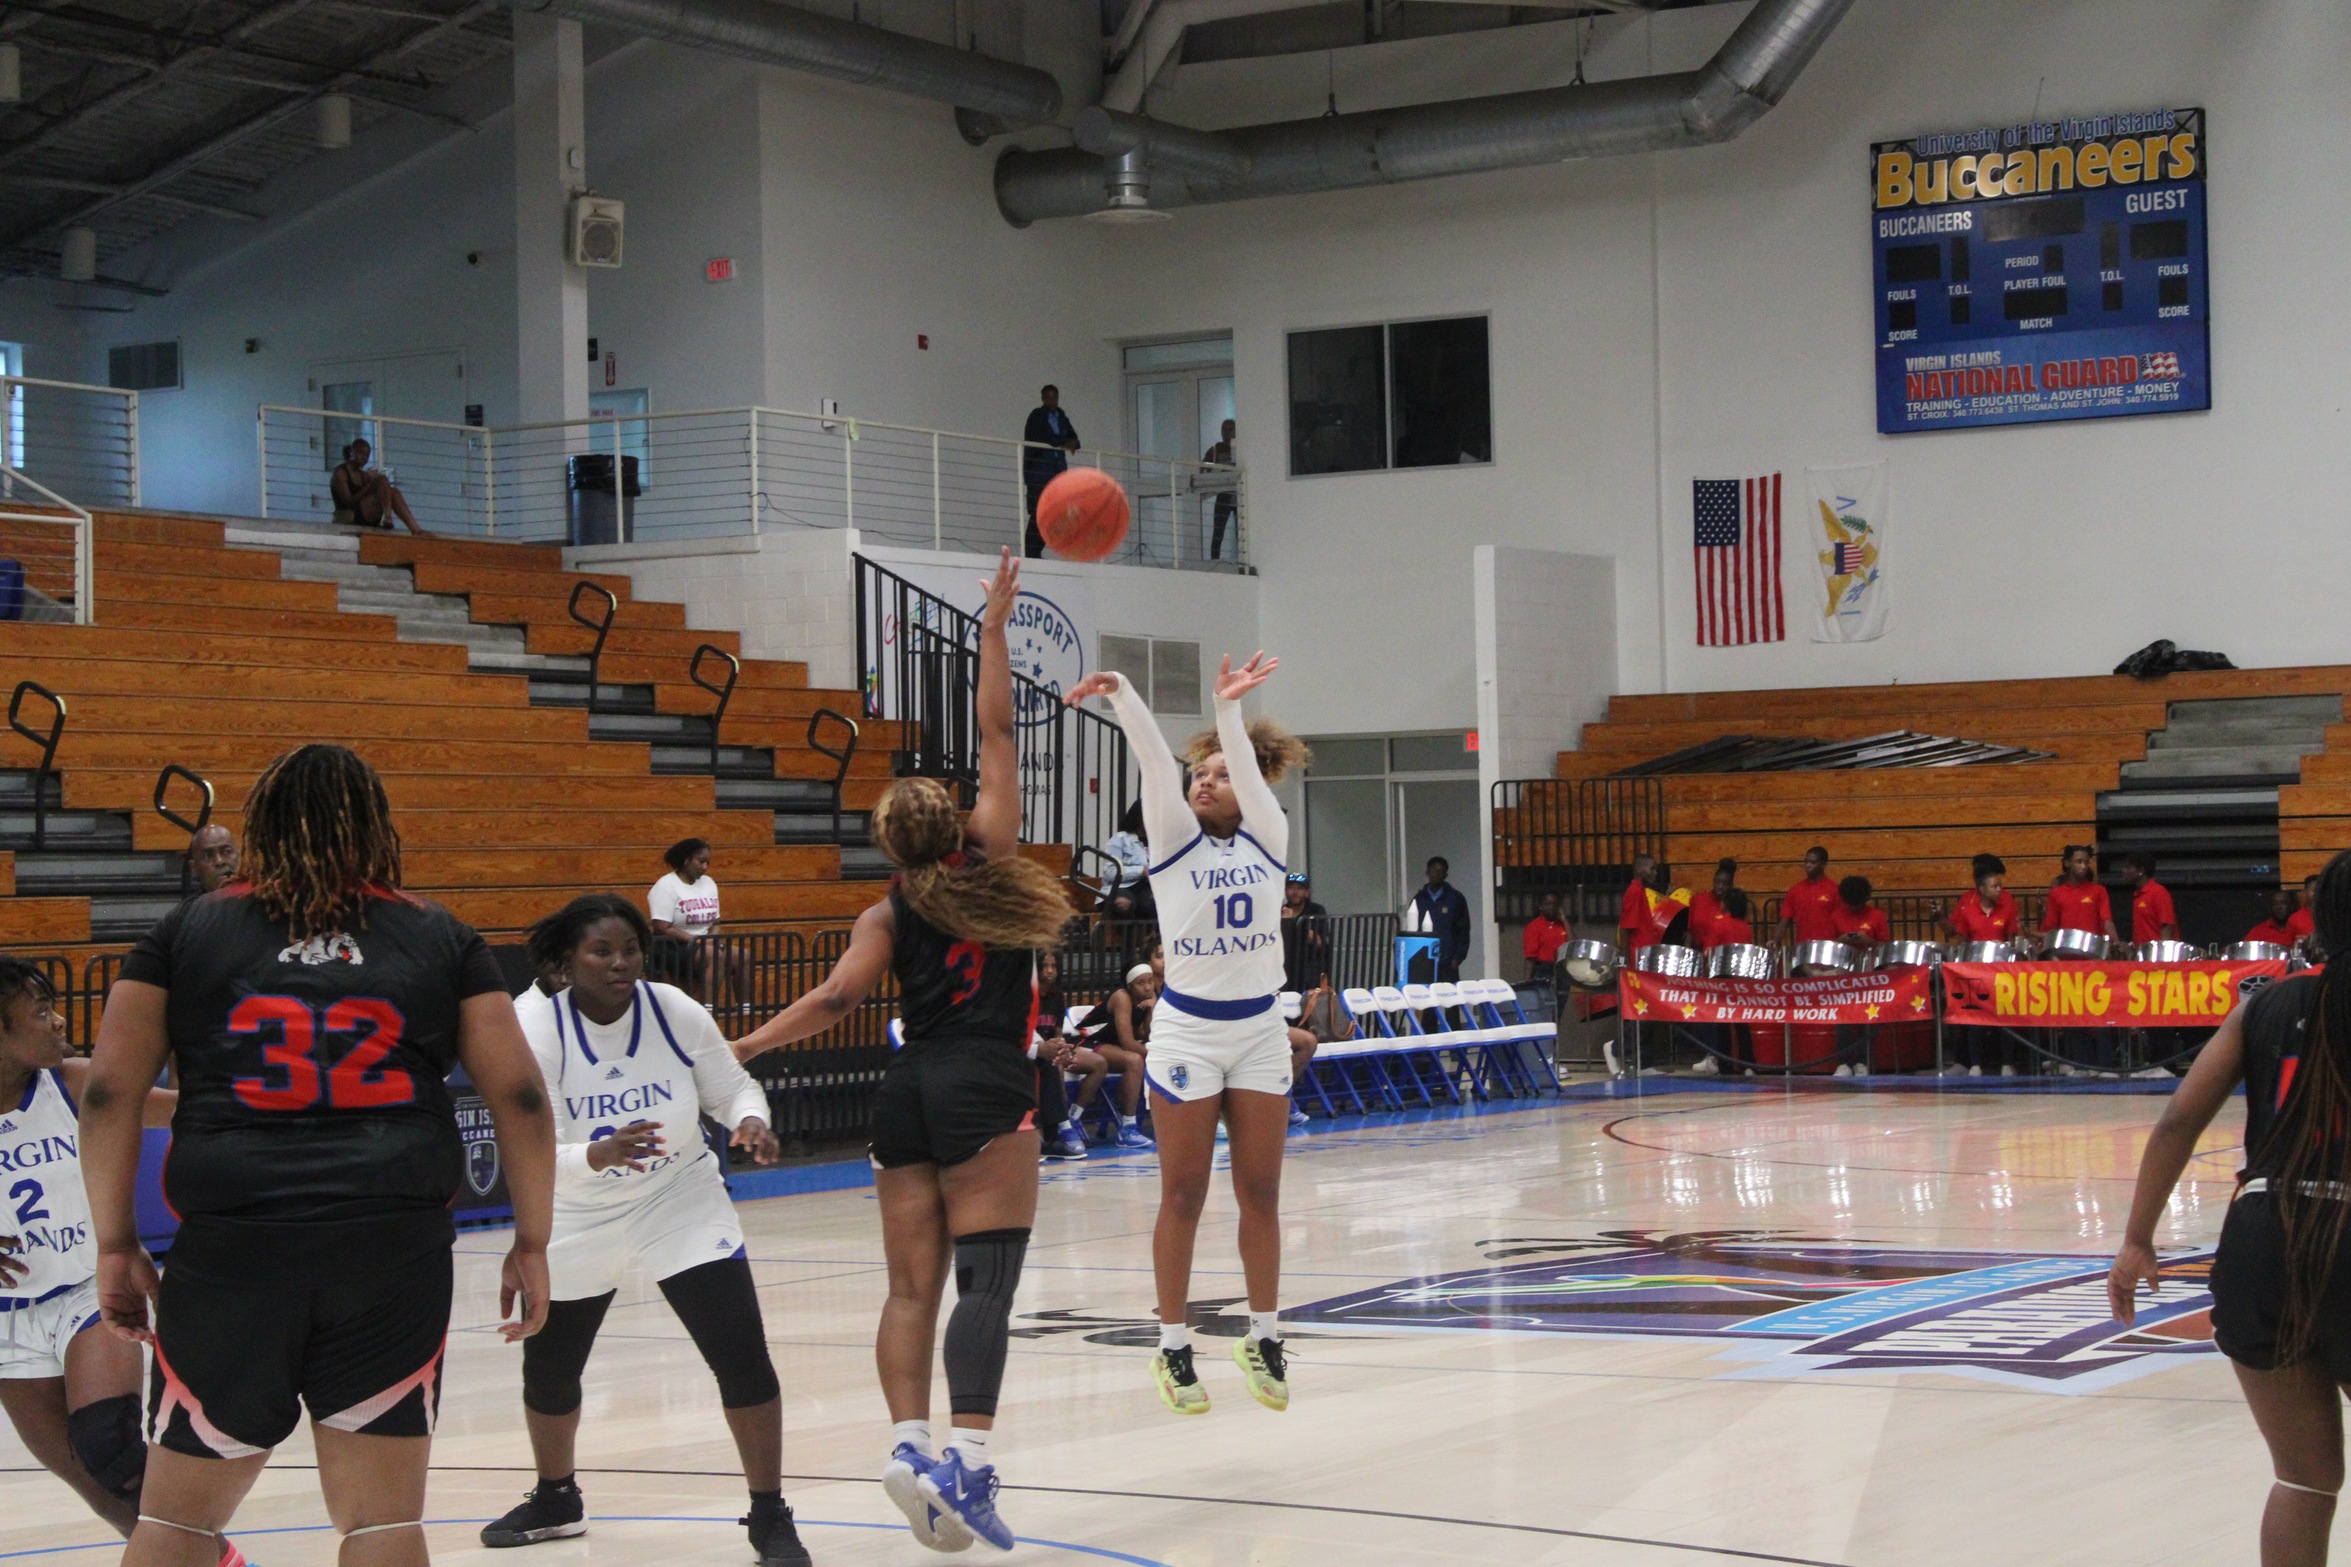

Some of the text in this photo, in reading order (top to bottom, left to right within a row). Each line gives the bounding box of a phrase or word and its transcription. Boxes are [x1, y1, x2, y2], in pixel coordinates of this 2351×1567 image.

[1917, 108, 2176, 156] University of the Virgin Islands
[1877, 133, 2195, 208] Buccaneers
[2125, 189, 2189, 213] GUEST
[1880, 211, 1972, 237] BUCCANEERS
[2005, 256, 2039, 268] PERIOD
[2158, 264, 2189, 276] FOULS
[2004, 276, 2066, 290] PLAYER FOUL
[2100, 270, 2125, 281] T.O.L.
[1888, 289, 1916, 301] FOULS
[1948, 284, 1972, 295] T.O.L.
[2020, 318, 2053, 330] MATCH
[2158, 305, 2190, 318] SCORE
[1888, 329, 1917, 341] SCORE
[1906, 351, 2001, 371] VIRGIN ISLANDS
[1906, 355, 2138, 400] NATIONAL GUARD
[1906, 400, 1961, 412] TRAINING
[1972, 394, 2040, 408] EDUCATION
[2051, 386, 2124, 401] ADVENTURE
[2135, 382, 2179, 395] MONEY
[2023, 402, 2059, 411] THOMAS
[2061, 400, 2079, 409] AND
[1008, 602, 1073, 653] ASSPORT
[1190, 863, 1269, 890] VIRGIN
[1213, 892, 1253, 929] 10
[1173, 930, 1276, 956] ISLANDS
[1666, 974, 1890, 994] NOTHING IS SO COMPLICATED
[1994, 969, 2231, 1016] RISING STARS
[1659, 989, 1895, 1007] THAT IT CANNOT BE SIMPLIFIED
[1716, 1007, 1838, 1020] BY HARD WORK
[228, 994, 414, 1110] 32
[565, 1080, 673, 1120] VIRGIN
[0, 1134, 77, 1176] RGIN
[9, 1178, 50, 1226] 2
[1819, 1288, 1968, 1313] VIRGIN
[1936, 1260, 2108, 1288] ISLANDS
